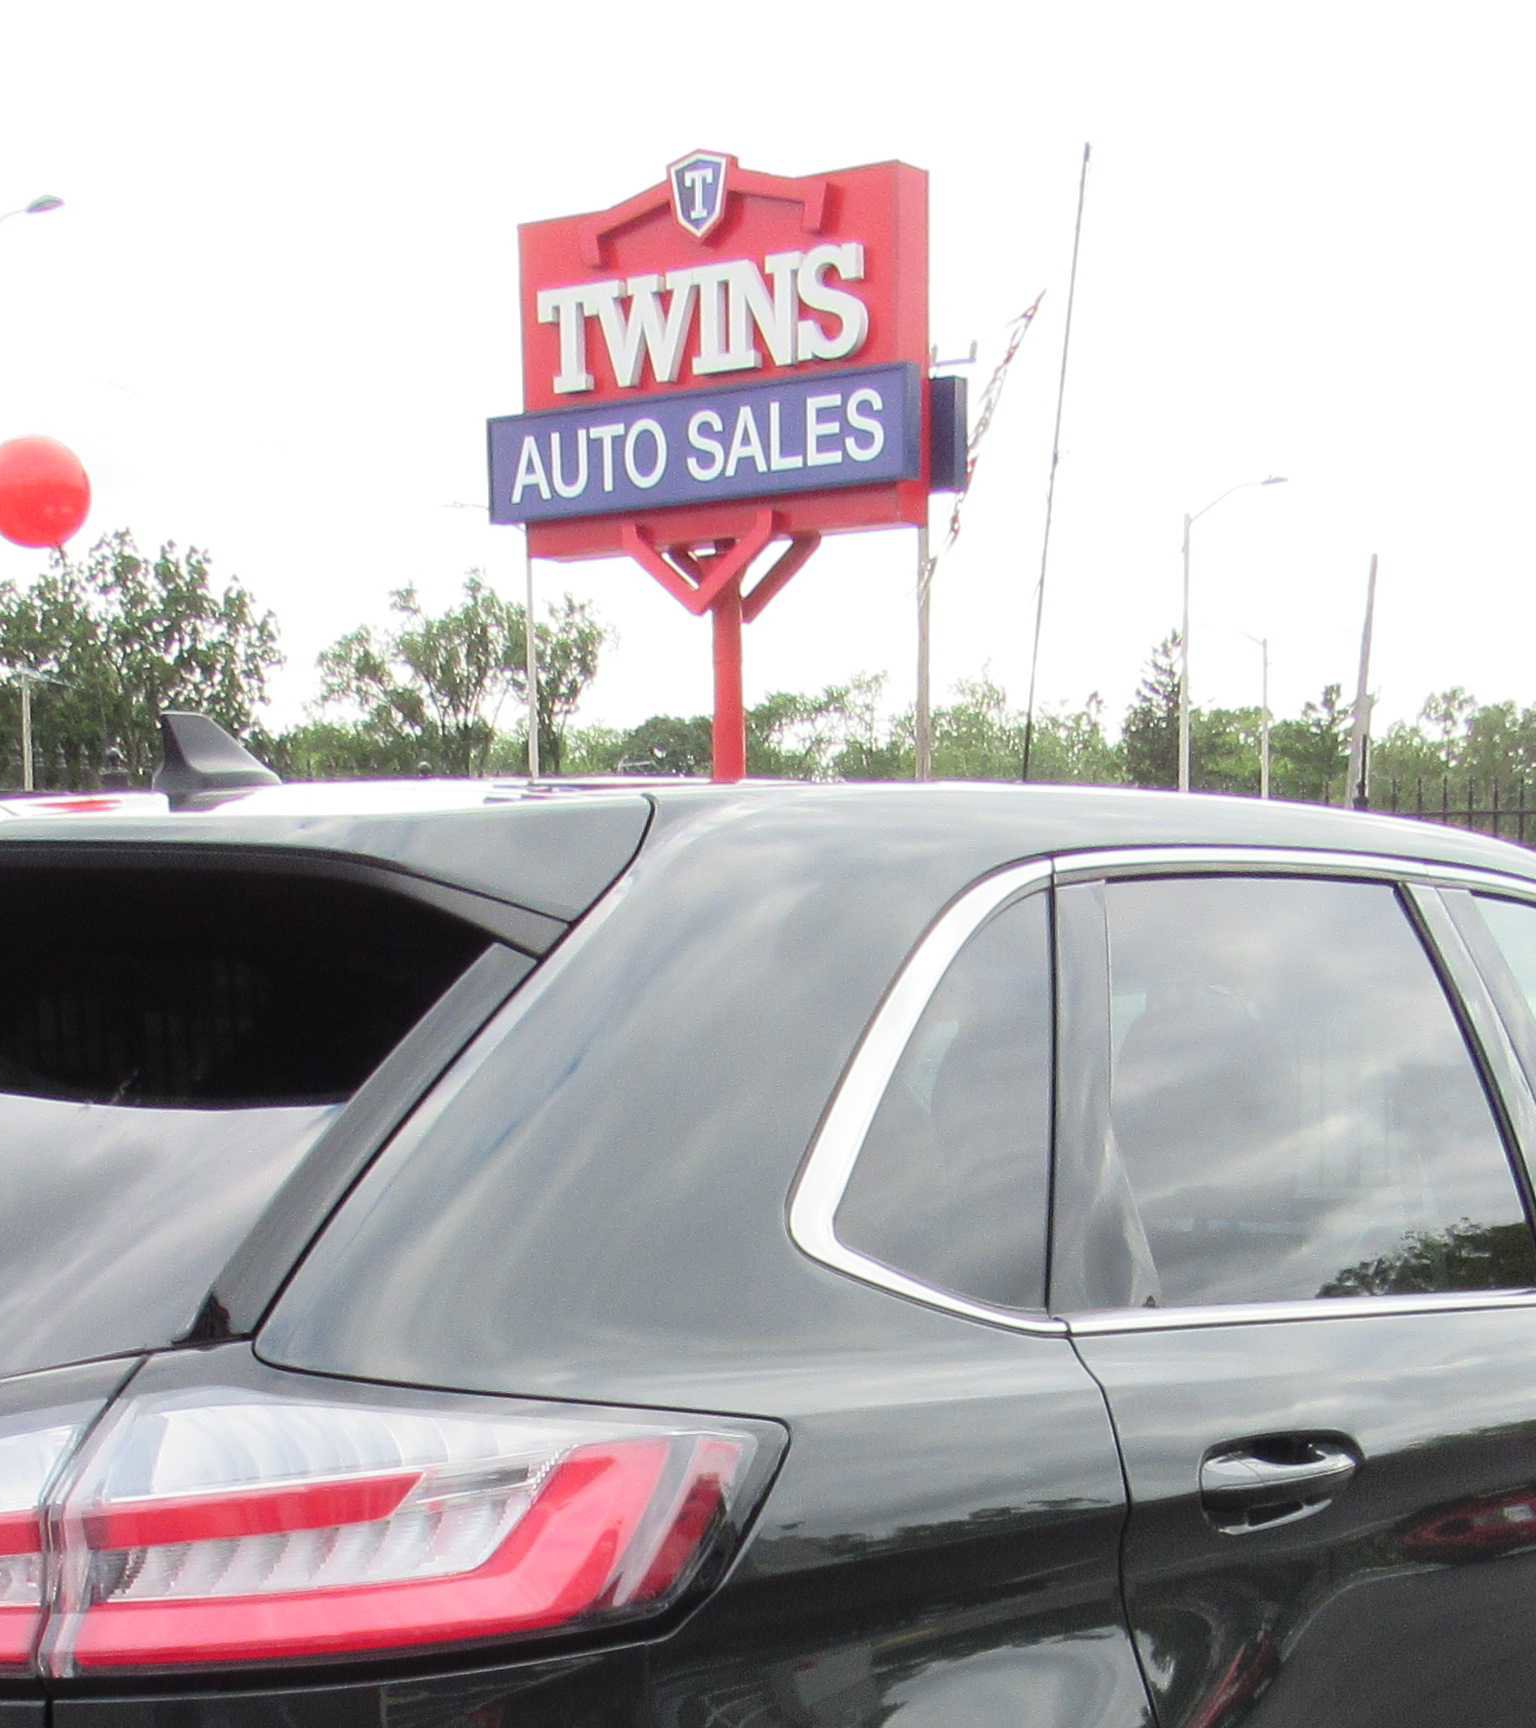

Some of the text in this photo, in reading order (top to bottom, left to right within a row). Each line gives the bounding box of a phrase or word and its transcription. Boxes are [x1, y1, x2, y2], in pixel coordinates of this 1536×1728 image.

[684, 168, 713, 219] T
[537, 242, 868, 394] TWINS
[511, 388, 884, 504] AUTO SALES
